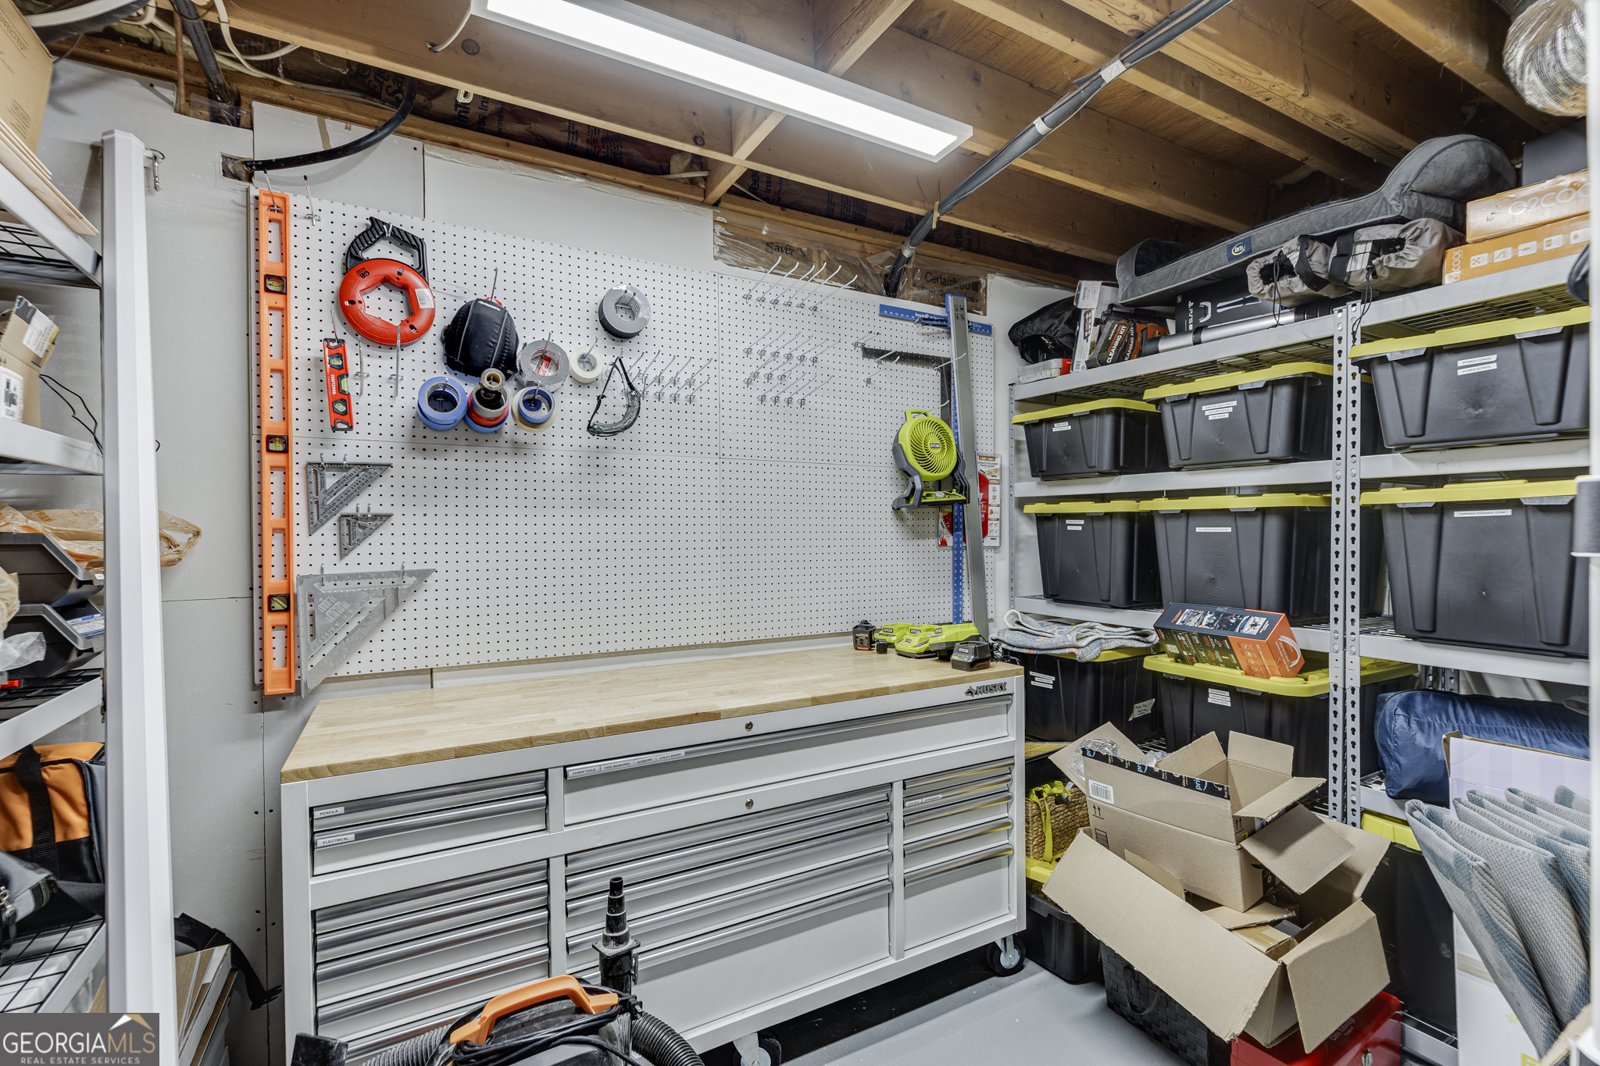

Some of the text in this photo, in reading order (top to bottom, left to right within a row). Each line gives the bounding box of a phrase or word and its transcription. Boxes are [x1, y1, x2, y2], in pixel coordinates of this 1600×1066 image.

[1106, 334, 1121, 364] CLEANING
[1119, 324, 1127, 339] KIT
[975, 681, 1007, 695] HUSKY
[322, 837, 349, 845] ELECTRICAL
